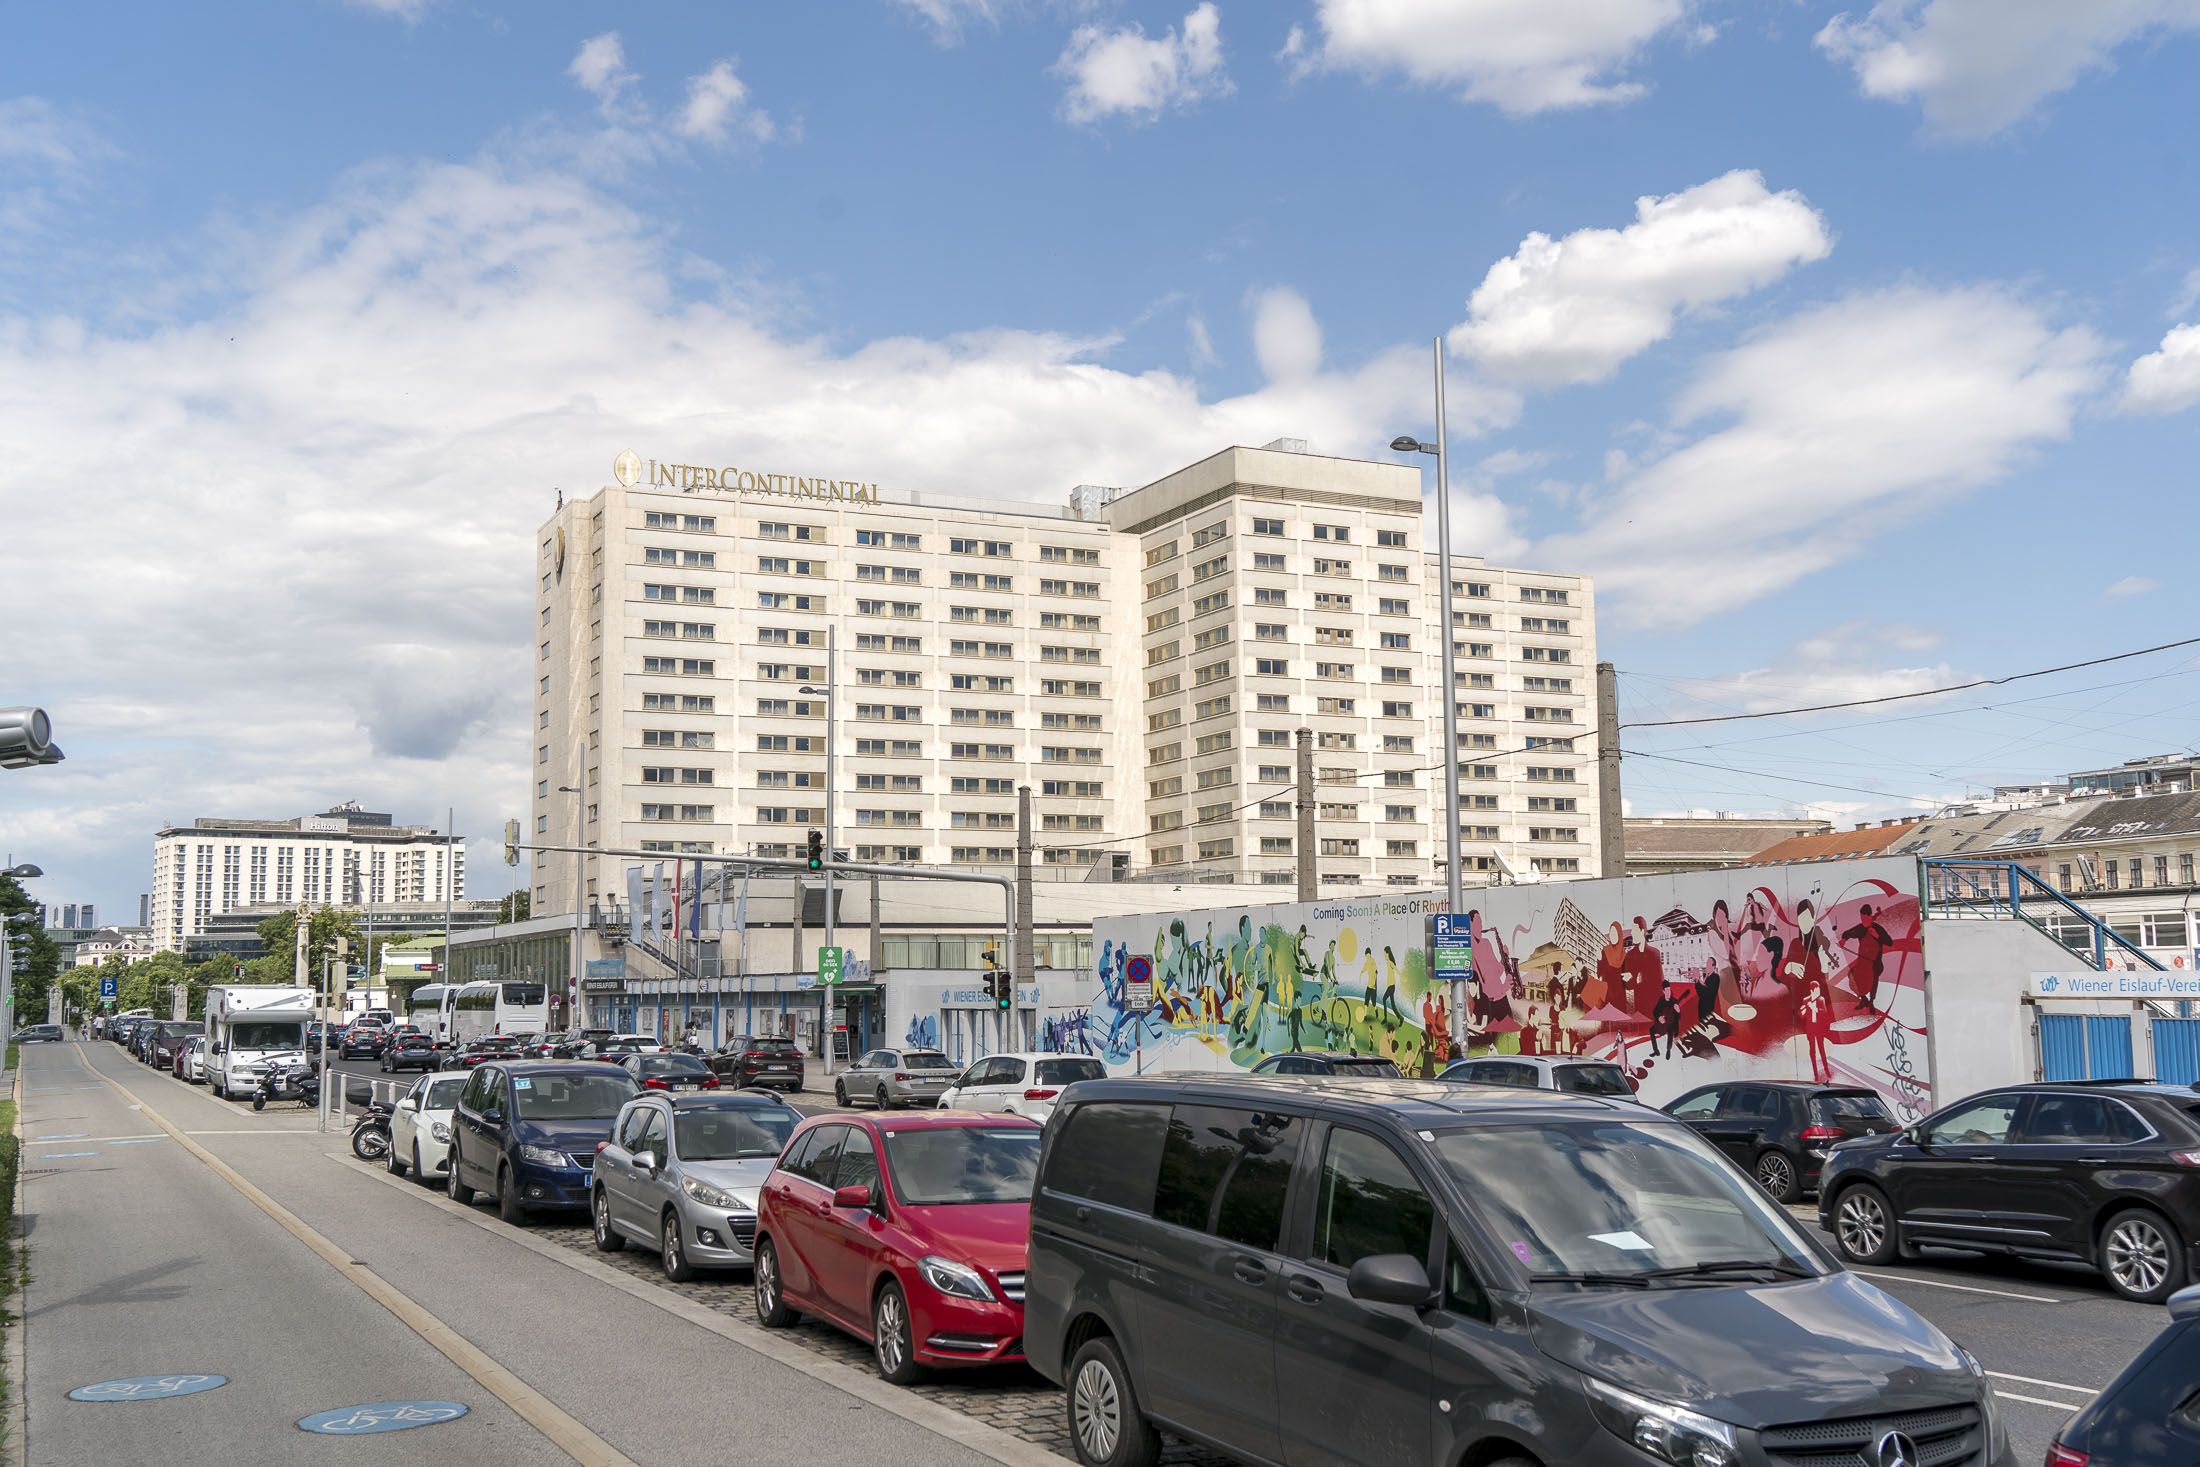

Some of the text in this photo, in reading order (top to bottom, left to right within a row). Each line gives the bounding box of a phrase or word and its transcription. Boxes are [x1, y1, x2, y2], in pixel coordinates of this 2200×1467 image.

[649, 459, 882, 506] INTERCONTINENTAL
[310, 821, 338, 831] Hilton
[1313, 906, 1345, 921] Coming
[1374, 903, 1381, 916] A
[1382, 902, 1407, 915] Place
[1409, 901, 1420, 914] Of
[1423, 898, 1451, 914] Rhyth
[1437, 920, 1448, 933] P
[104, 982, 114, 995] P
[2068, 977, 2113, 992] Wiener
[954, 990, 976, 1003] WIENER
